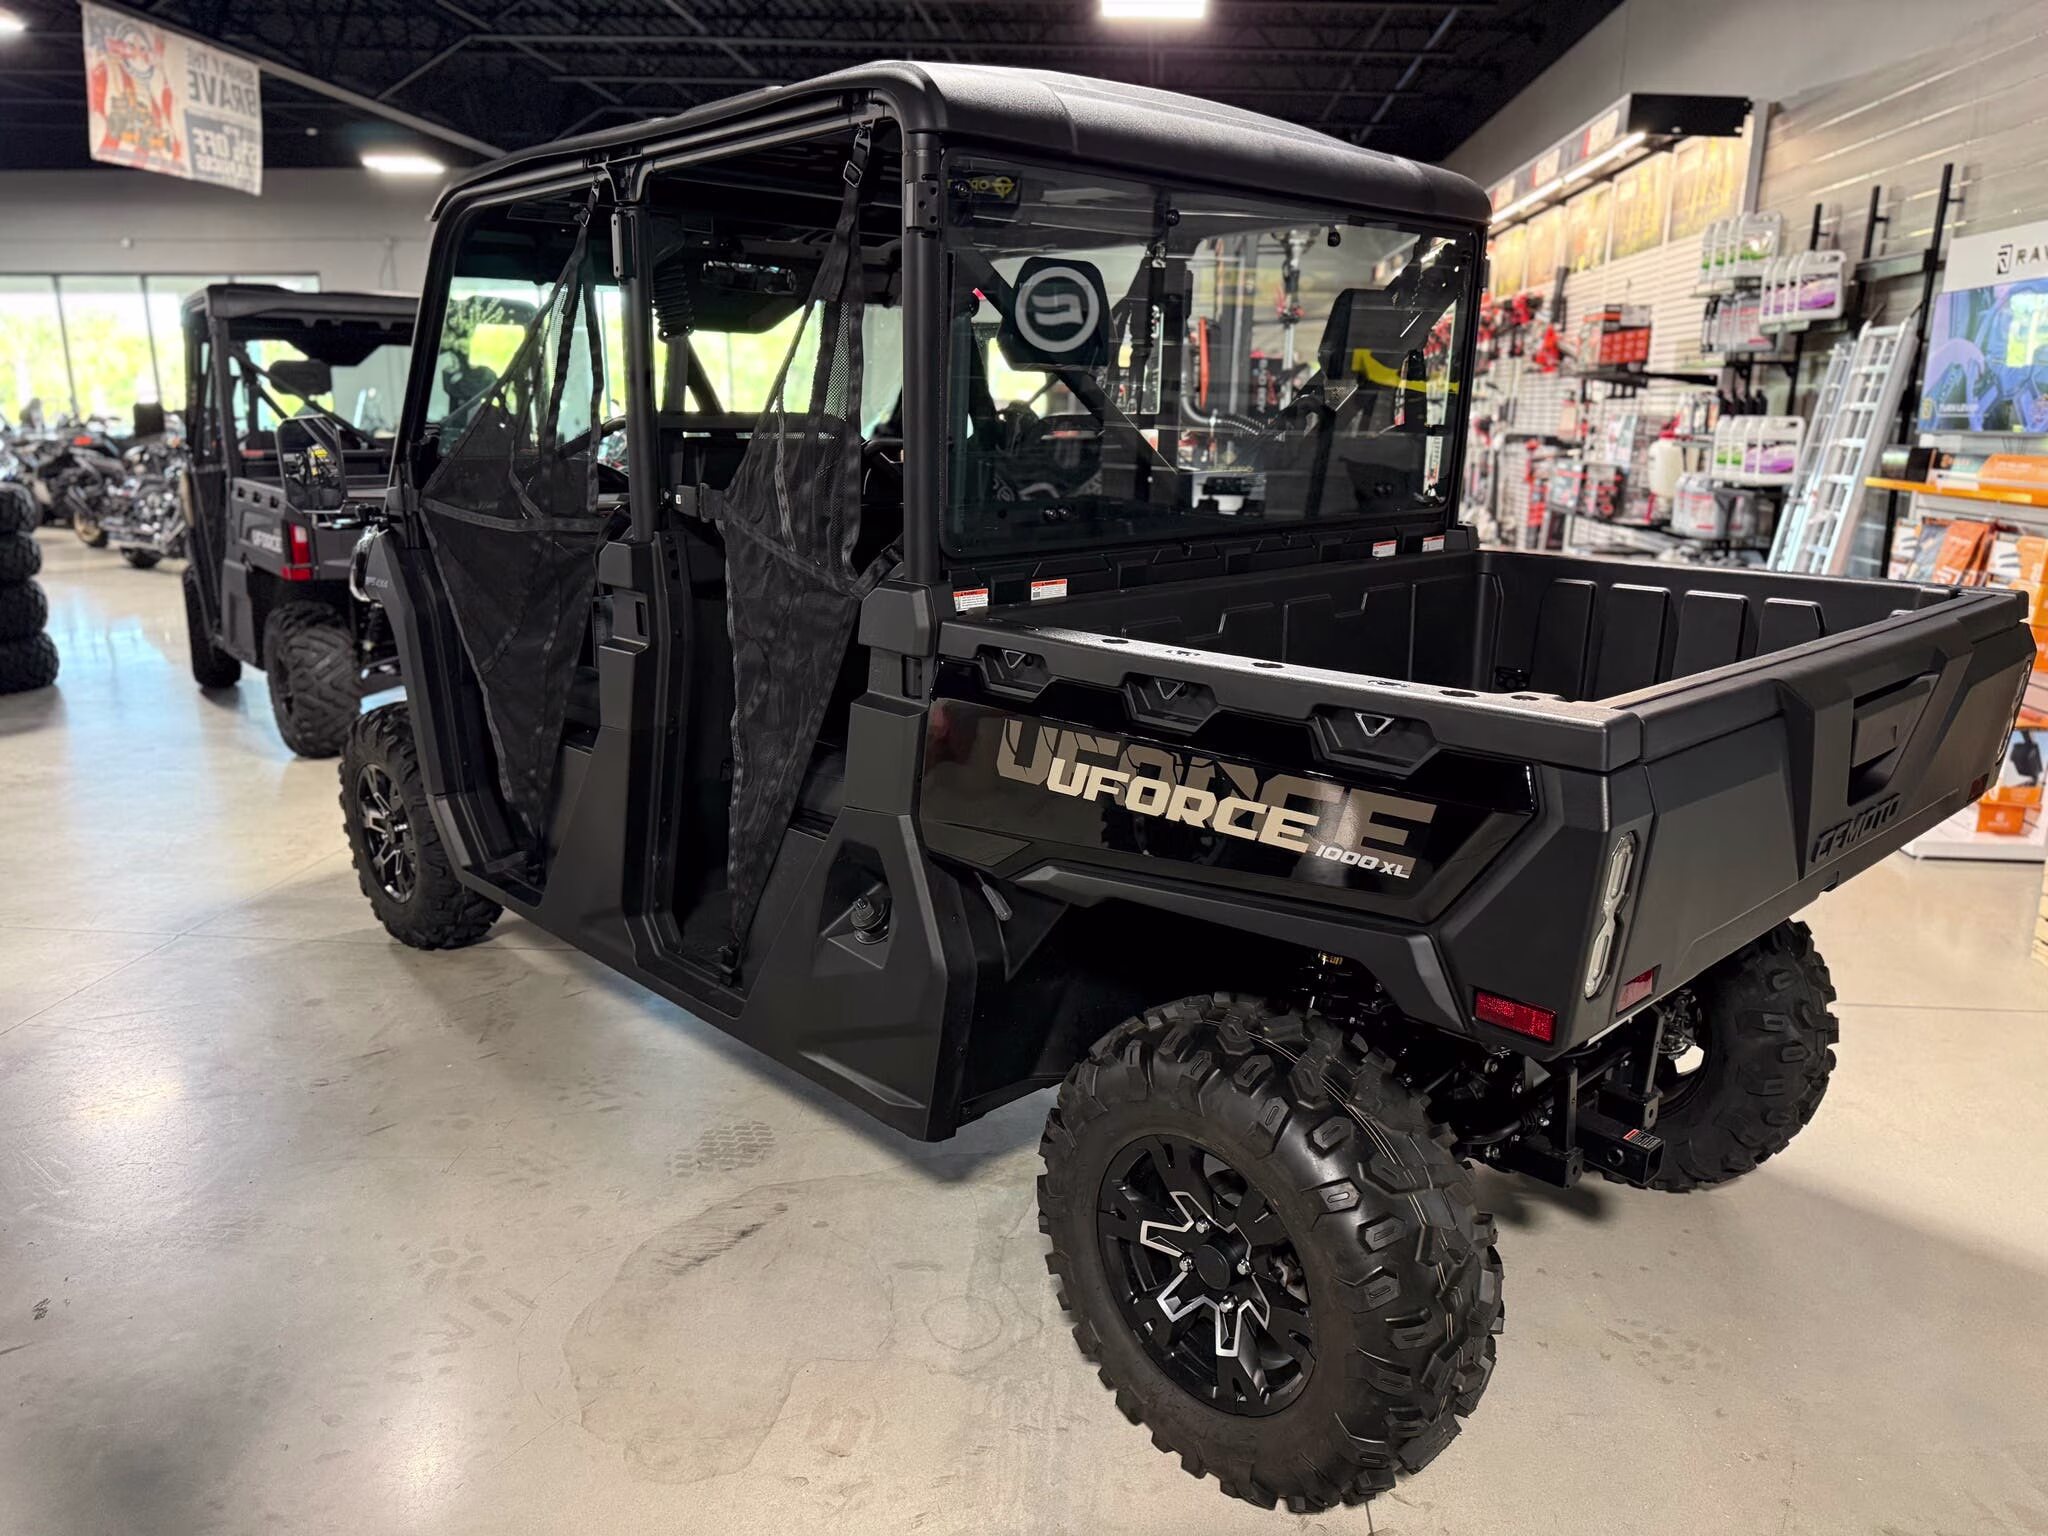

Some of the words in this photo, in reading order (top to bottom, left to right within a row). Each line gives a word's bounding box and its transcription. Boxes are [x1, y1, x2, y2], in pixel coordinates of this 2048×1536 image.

[1046, 757, 1320, 854] UFORCE
[1810, 792, 1901, 863] CFMOTO
[1315, 844, 1380, 870] 1000
[1379, 861, 1410, 879] XL
